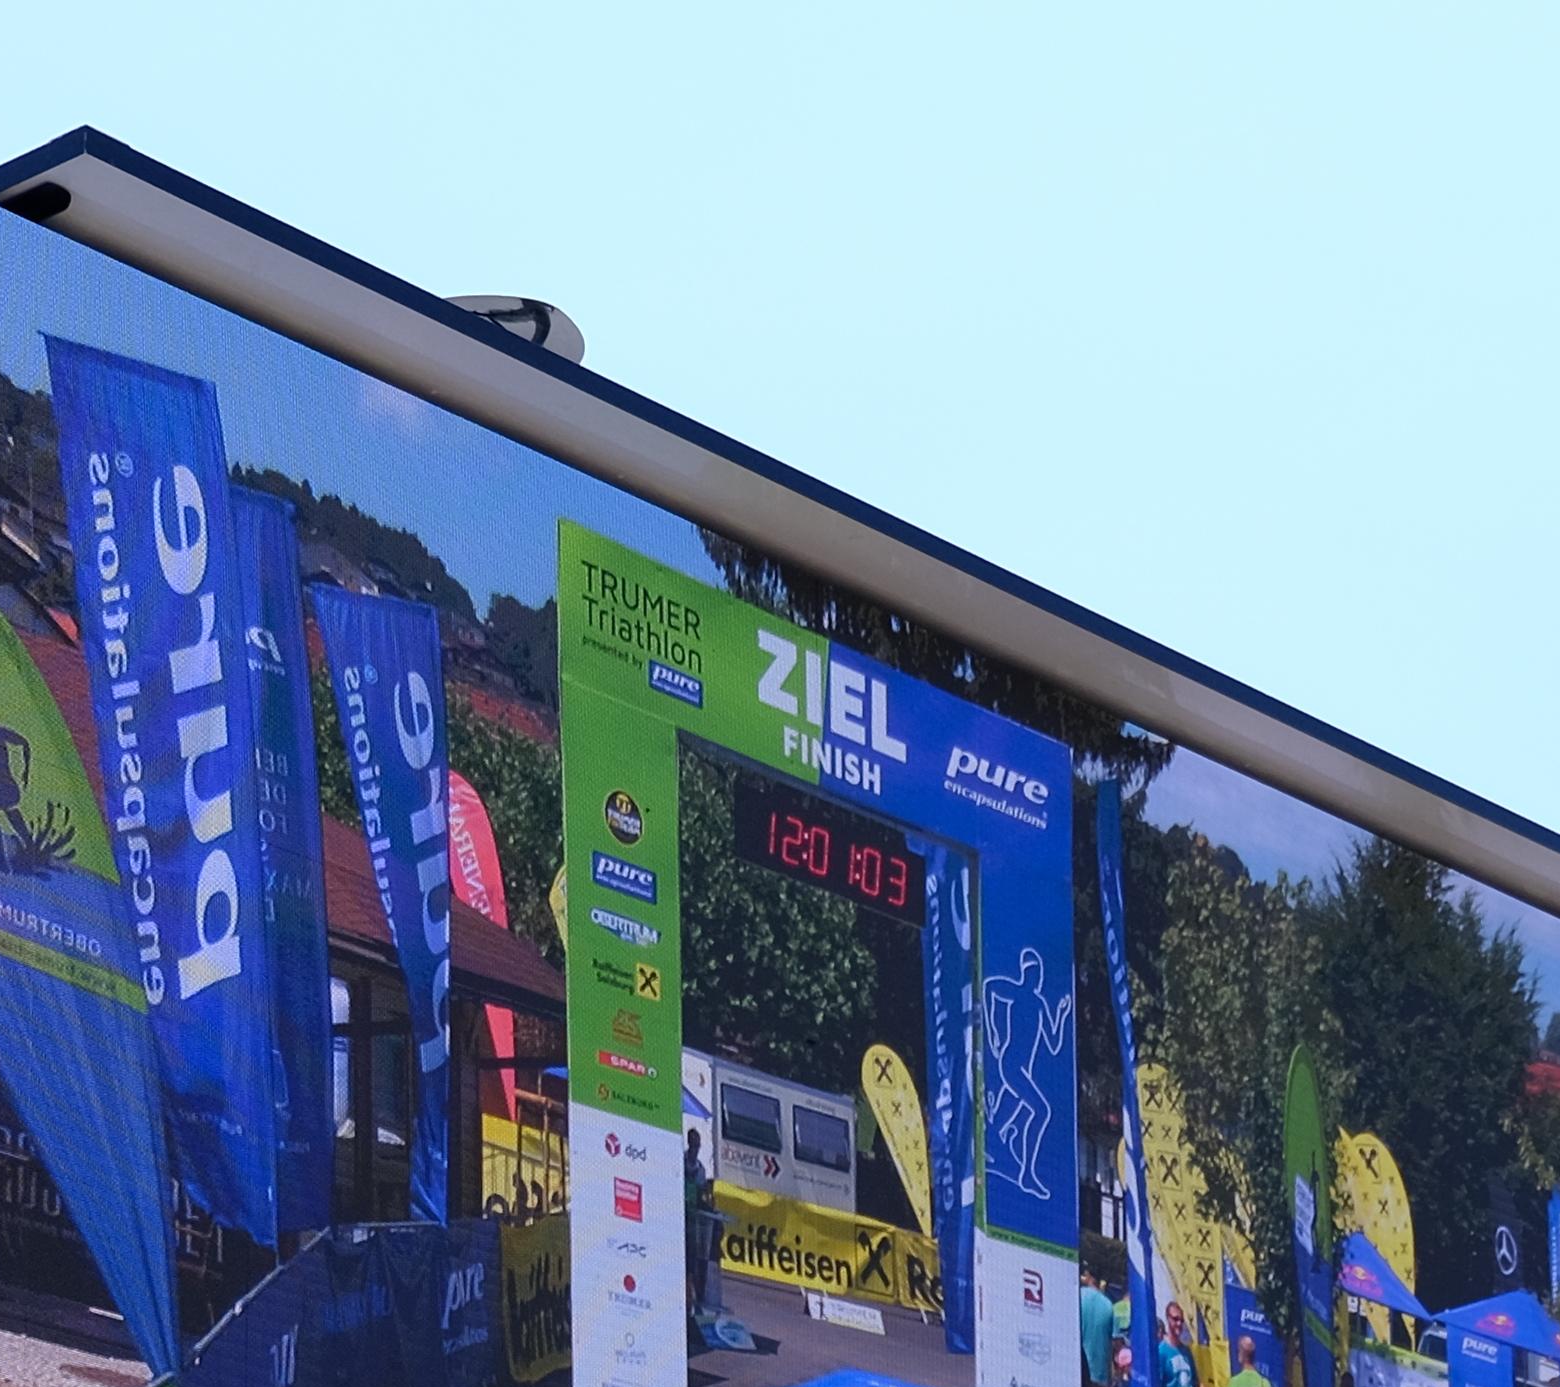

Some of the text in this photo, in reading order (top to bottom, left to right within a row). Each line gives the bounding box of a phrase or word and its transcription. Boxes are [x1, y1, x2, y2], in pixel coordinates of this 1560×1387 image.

[580, 560, 701, 641] TRUMER
[582, 594, 702, 674] Triathlon
[652, 664, 700, 692] pure
[756, 629, 907, 764] ZIEL
[783, 726, 881, 796] FINISH
[945, 746, 1049, 806] pure
[943, 778, 1048, 831] encapsulations
[595, 855, 654, 887] pure
[1461, 1336, 1498, 1356] pure
